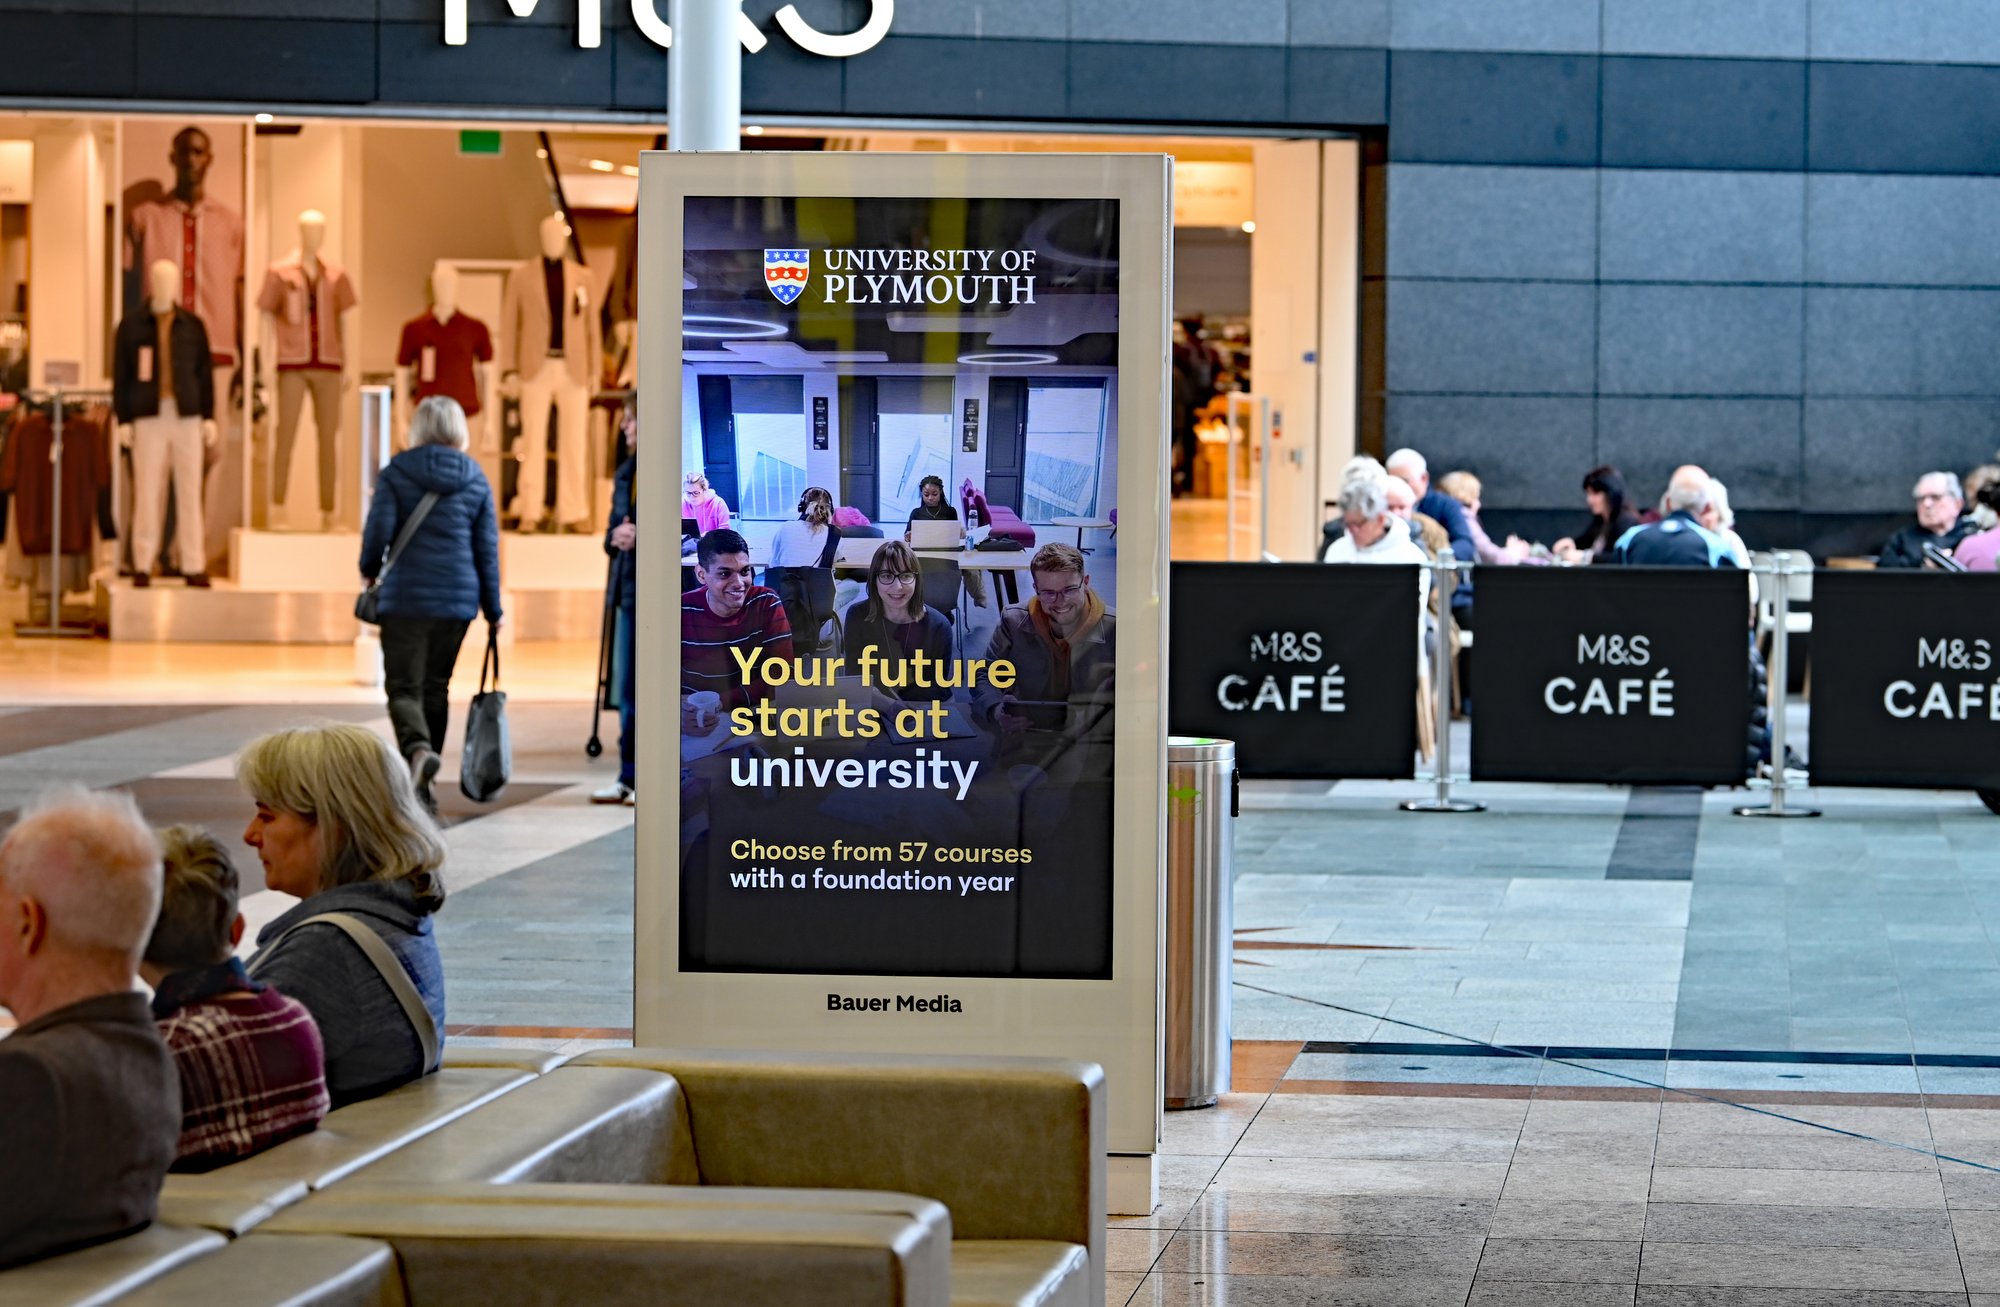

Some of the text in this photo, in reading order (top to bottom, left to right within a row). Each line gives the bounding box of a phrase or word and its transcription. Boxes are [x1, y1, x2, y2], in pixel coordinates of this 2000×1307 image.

[824, 250, 1036, 271] UNIVERSITY OF
[824, 275, 1036, 304] PLYMOUTH
[1251, 631, 1322, 662] M&S
[1578, 634, 1650, 666] M&S
[1918, 637, 1992, 671] M&S
[730, 645, 1015, 688] Your future
[1217, 664, 1346, 712] CAFÉ
[1544, 667, 1675, 717] CAFÉ
[731, 699, 947, 738] starts at
[731, 747, 978, 800] university
[731, 839, 1031, 863] Choose from 57 courses
[730, 868, 1014, 896] with a foundation year
[828, 994, 962, 1012] Bauer Media
